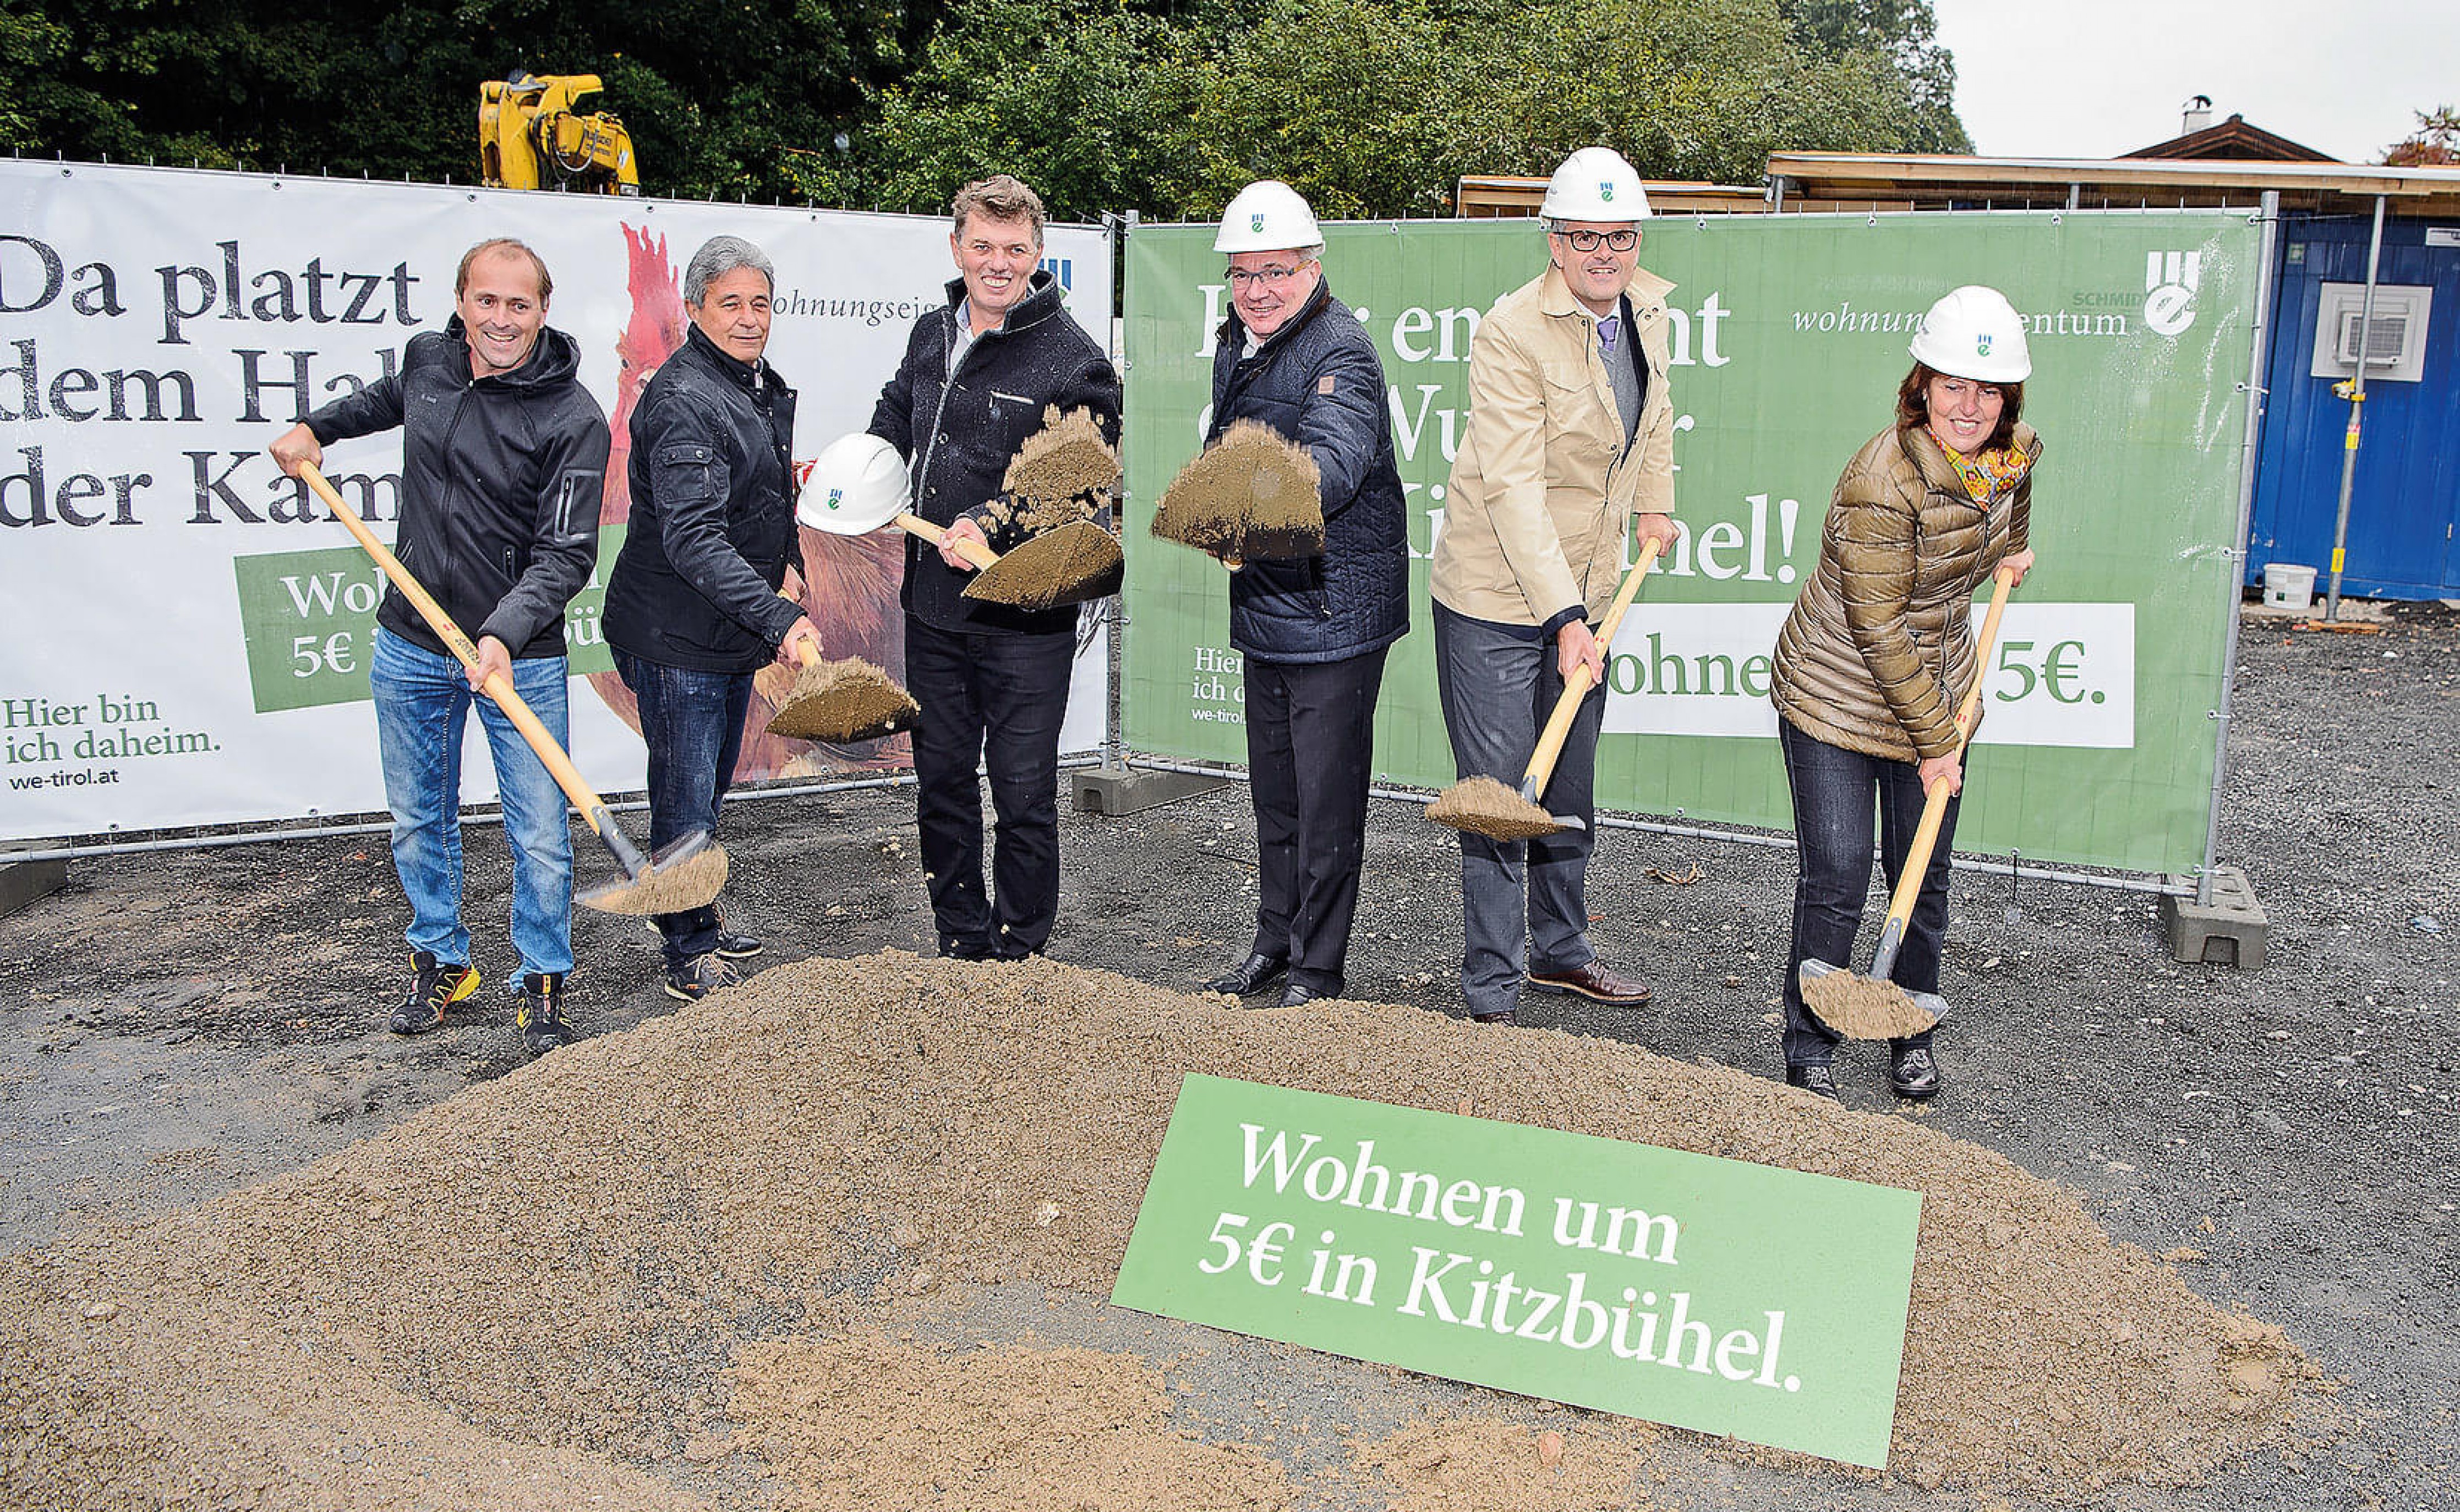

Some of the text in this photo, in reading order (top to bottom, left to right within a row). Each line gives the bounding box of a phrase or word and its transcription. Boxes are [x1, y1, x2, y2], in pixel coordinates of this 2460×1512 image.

[0, 235, 423, 344] Da platzt
[0, 339, 203, 422] dem
[0, 445, 153, 527] der
[292, 632, 357, 677] 5€
[1192, 676, 1226, 701] ich
[1609, 633, 2106, 704] ohne 5€.
[3, 693, 160, 728] Hier bin
[6, 728, 221, 764] ich daheim.
[9, 768, 119, 790] we-tirol.at
[1239, 1124, 1679, 1265] Wohnen um
[1199, 1213, 1802, 1392] 5€ in Kitzbühel.
